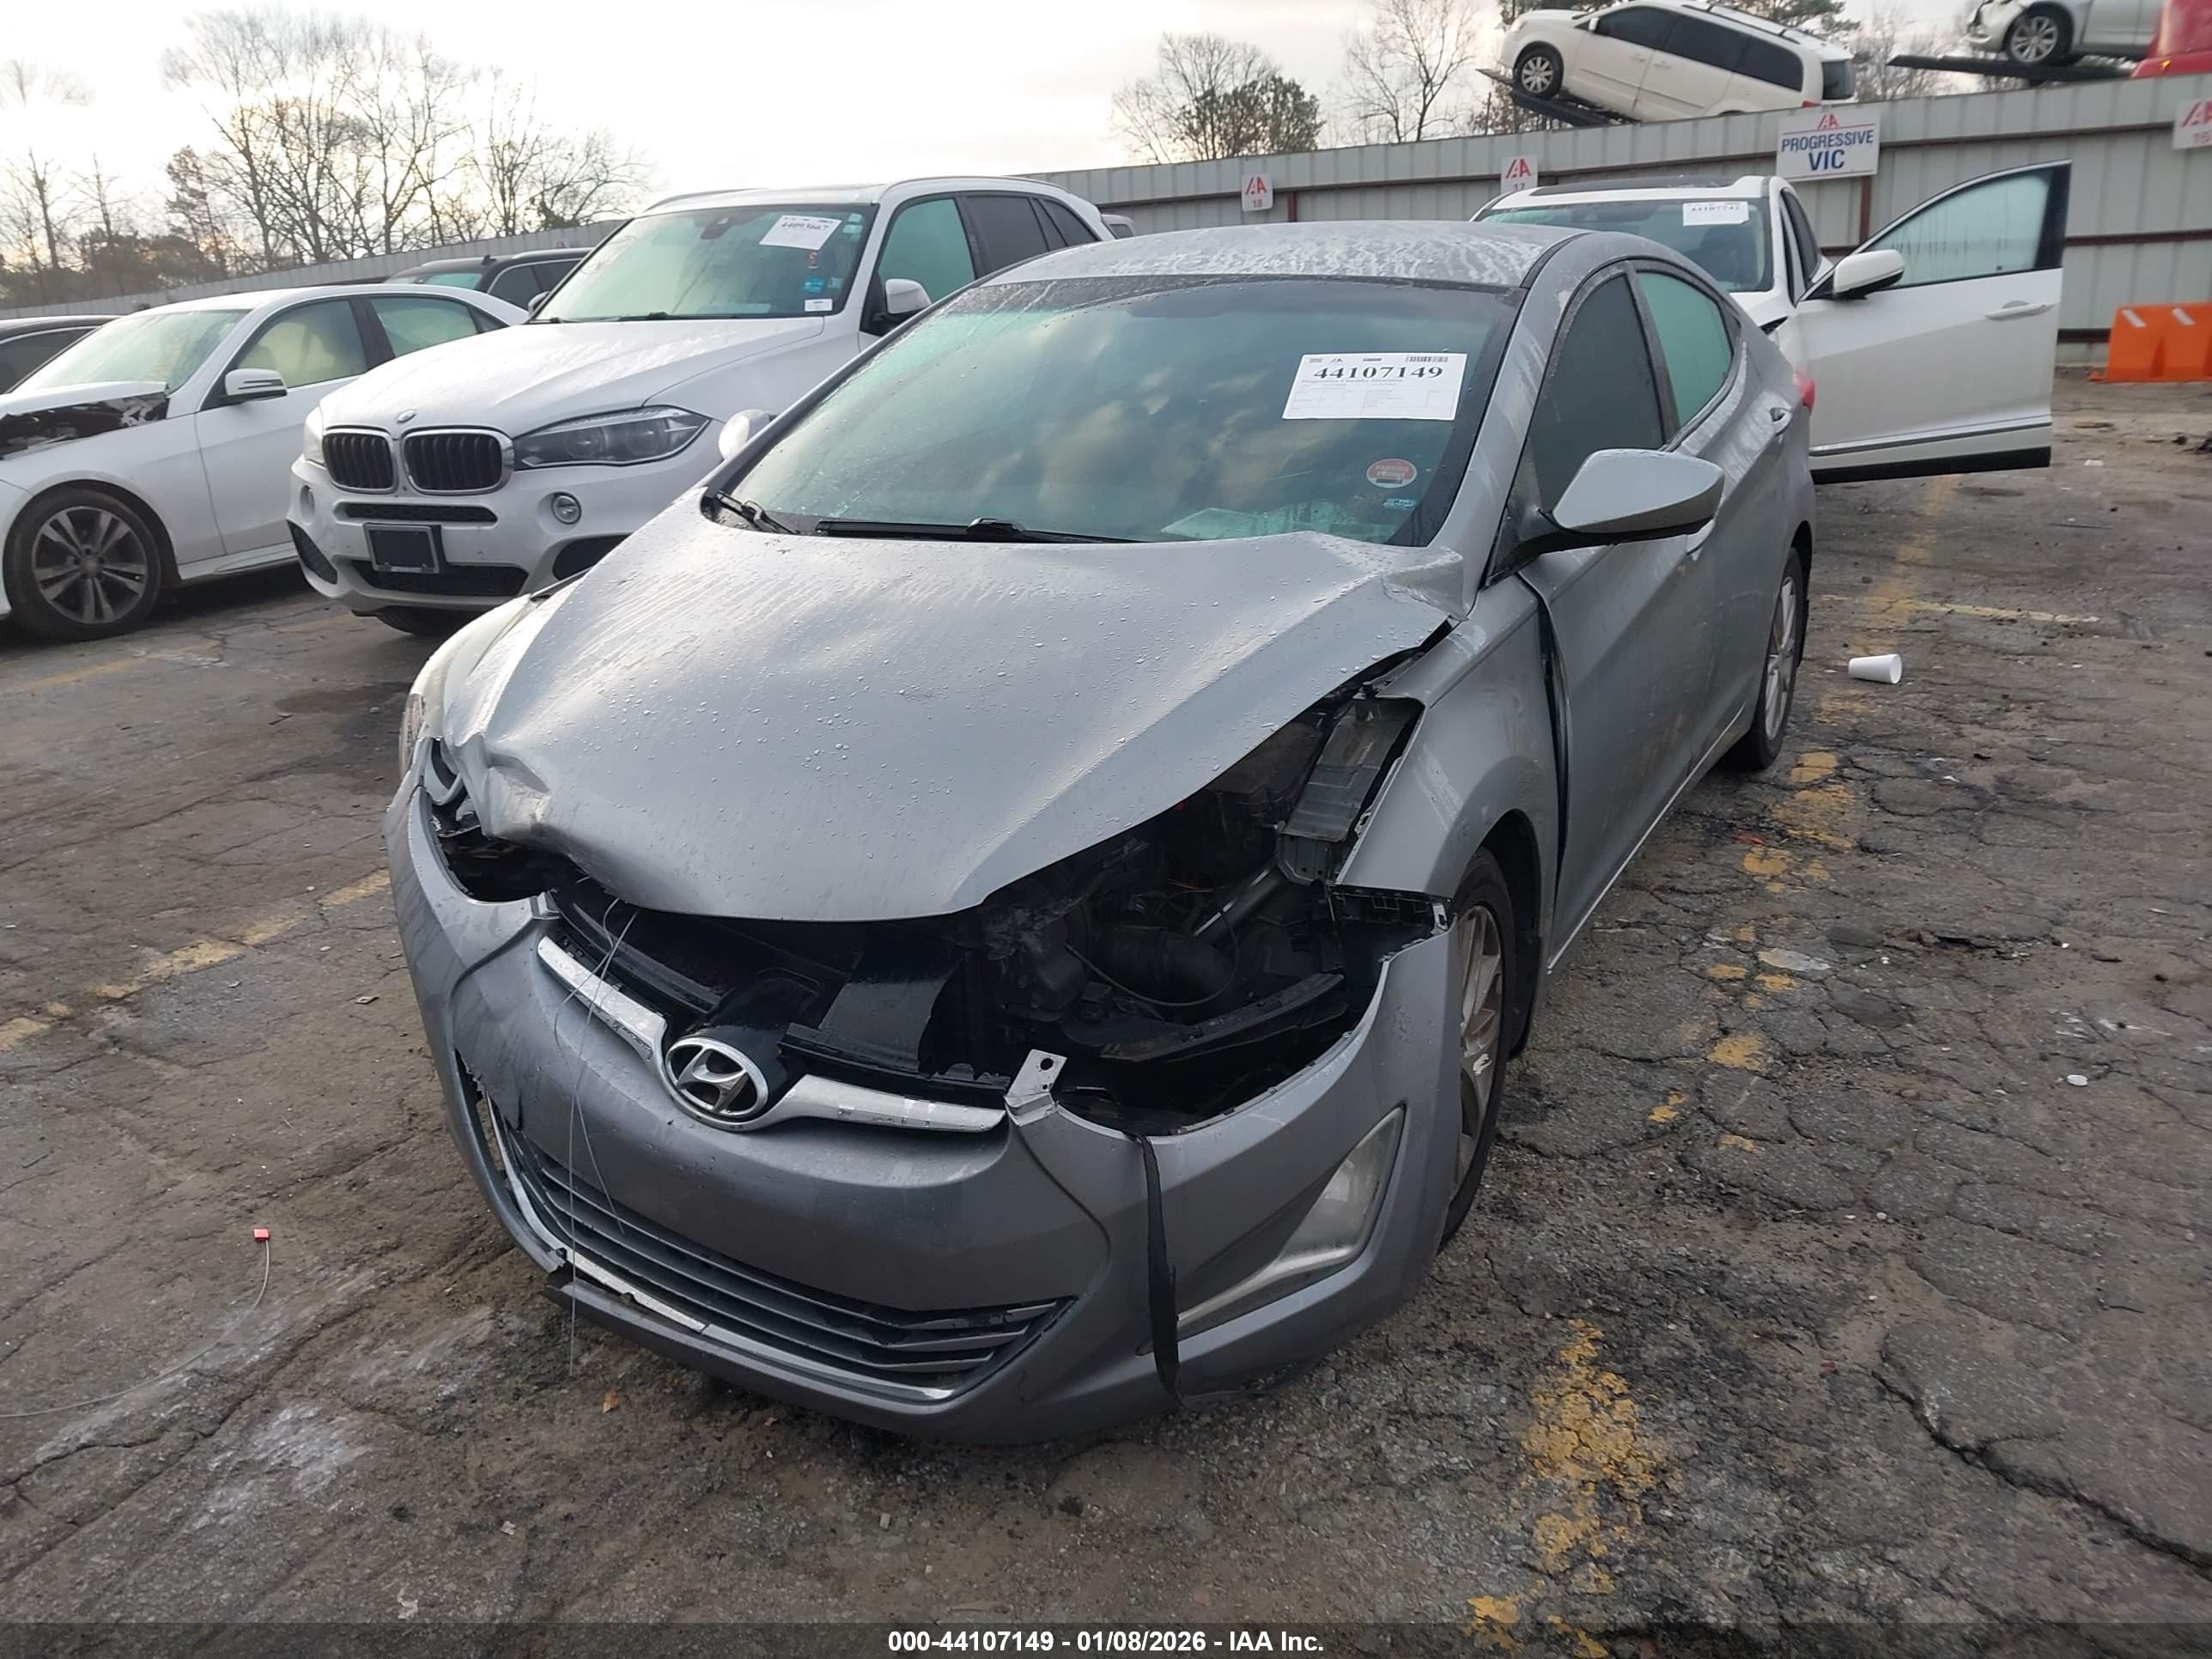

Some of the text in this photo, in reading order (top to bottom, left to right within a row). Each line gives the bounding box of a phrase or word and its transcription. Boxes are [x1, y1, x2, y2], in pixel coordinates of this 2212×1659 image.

[1781, 129, 1875, 153] PROGRESSIVE
[1808, 149, 1845, 171] VIC
[1313, 367, 1443, 379] 44107149
